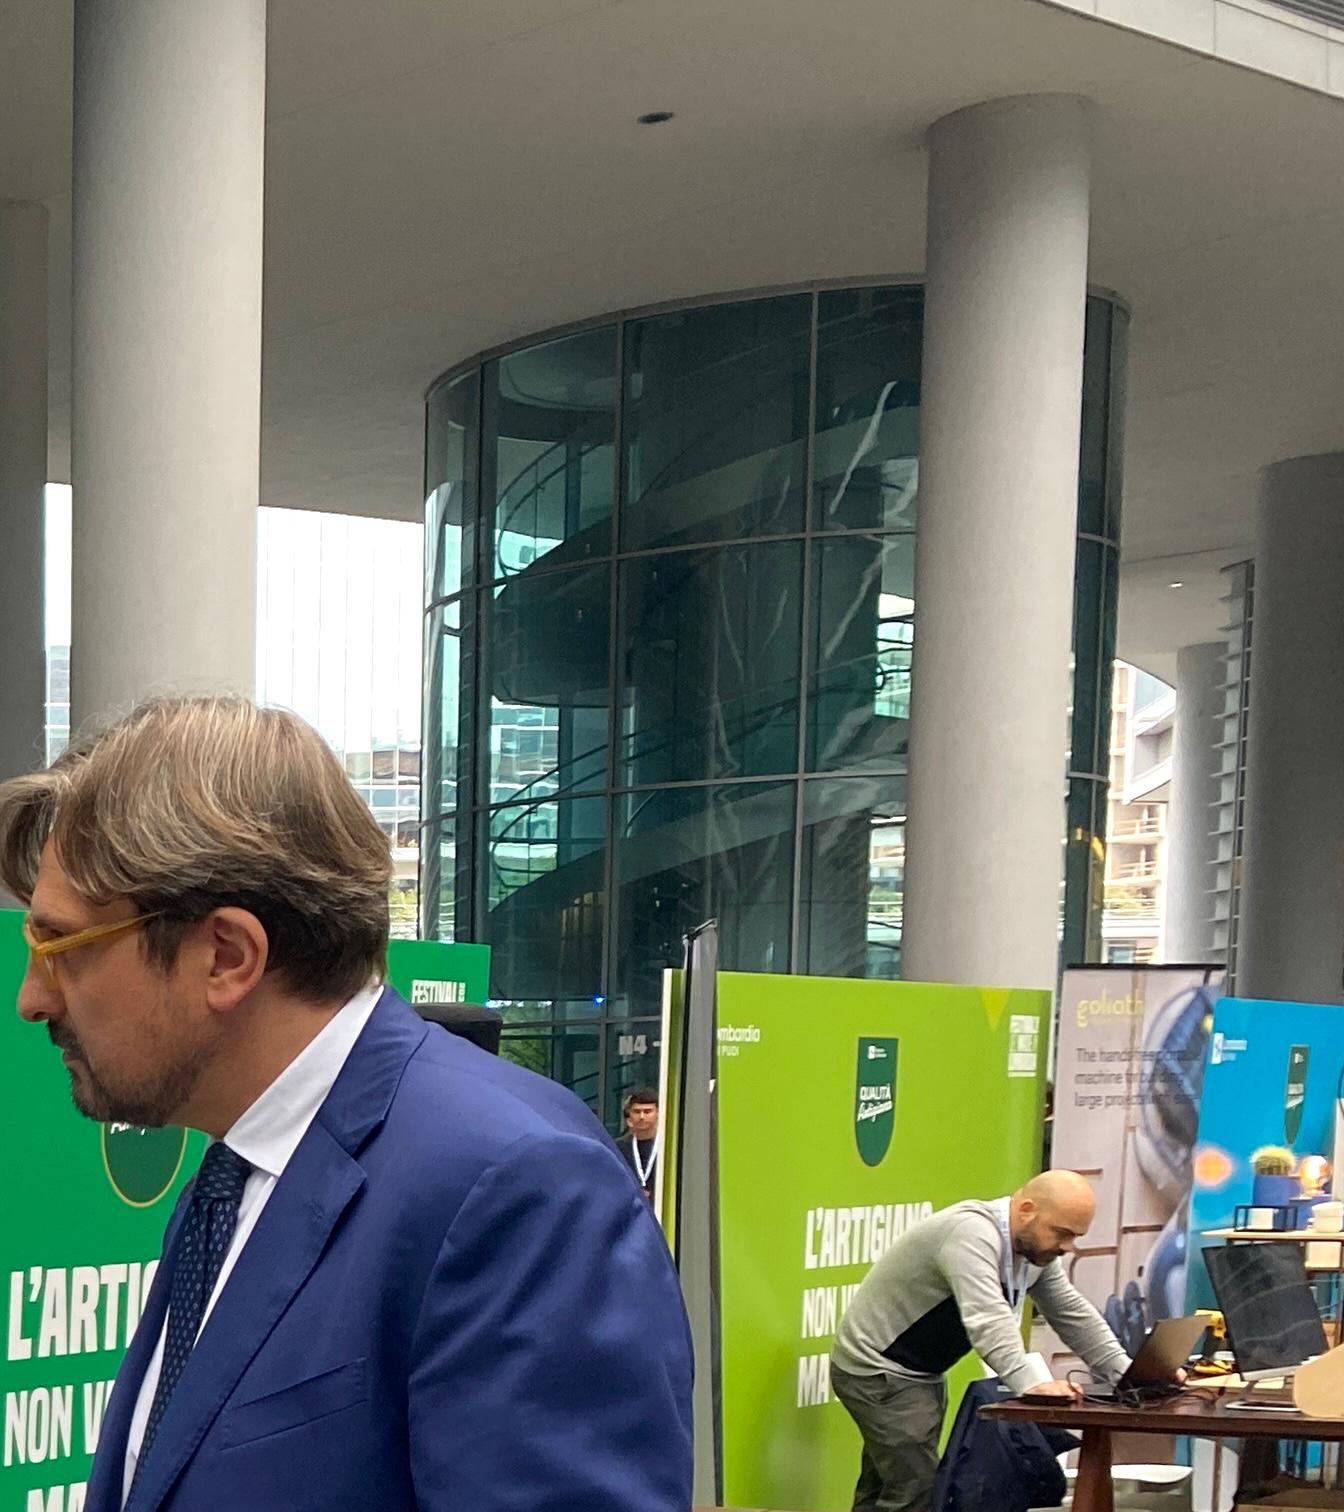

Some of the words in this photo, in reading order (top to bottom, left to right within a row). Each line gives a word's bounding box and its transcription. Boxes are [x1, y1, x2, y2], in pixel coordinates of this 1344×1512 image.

[801, 1286, 838, 1339] NON
[797, 1353, 830, 1409] MA
[3, 1385, 73, 1467] NON
